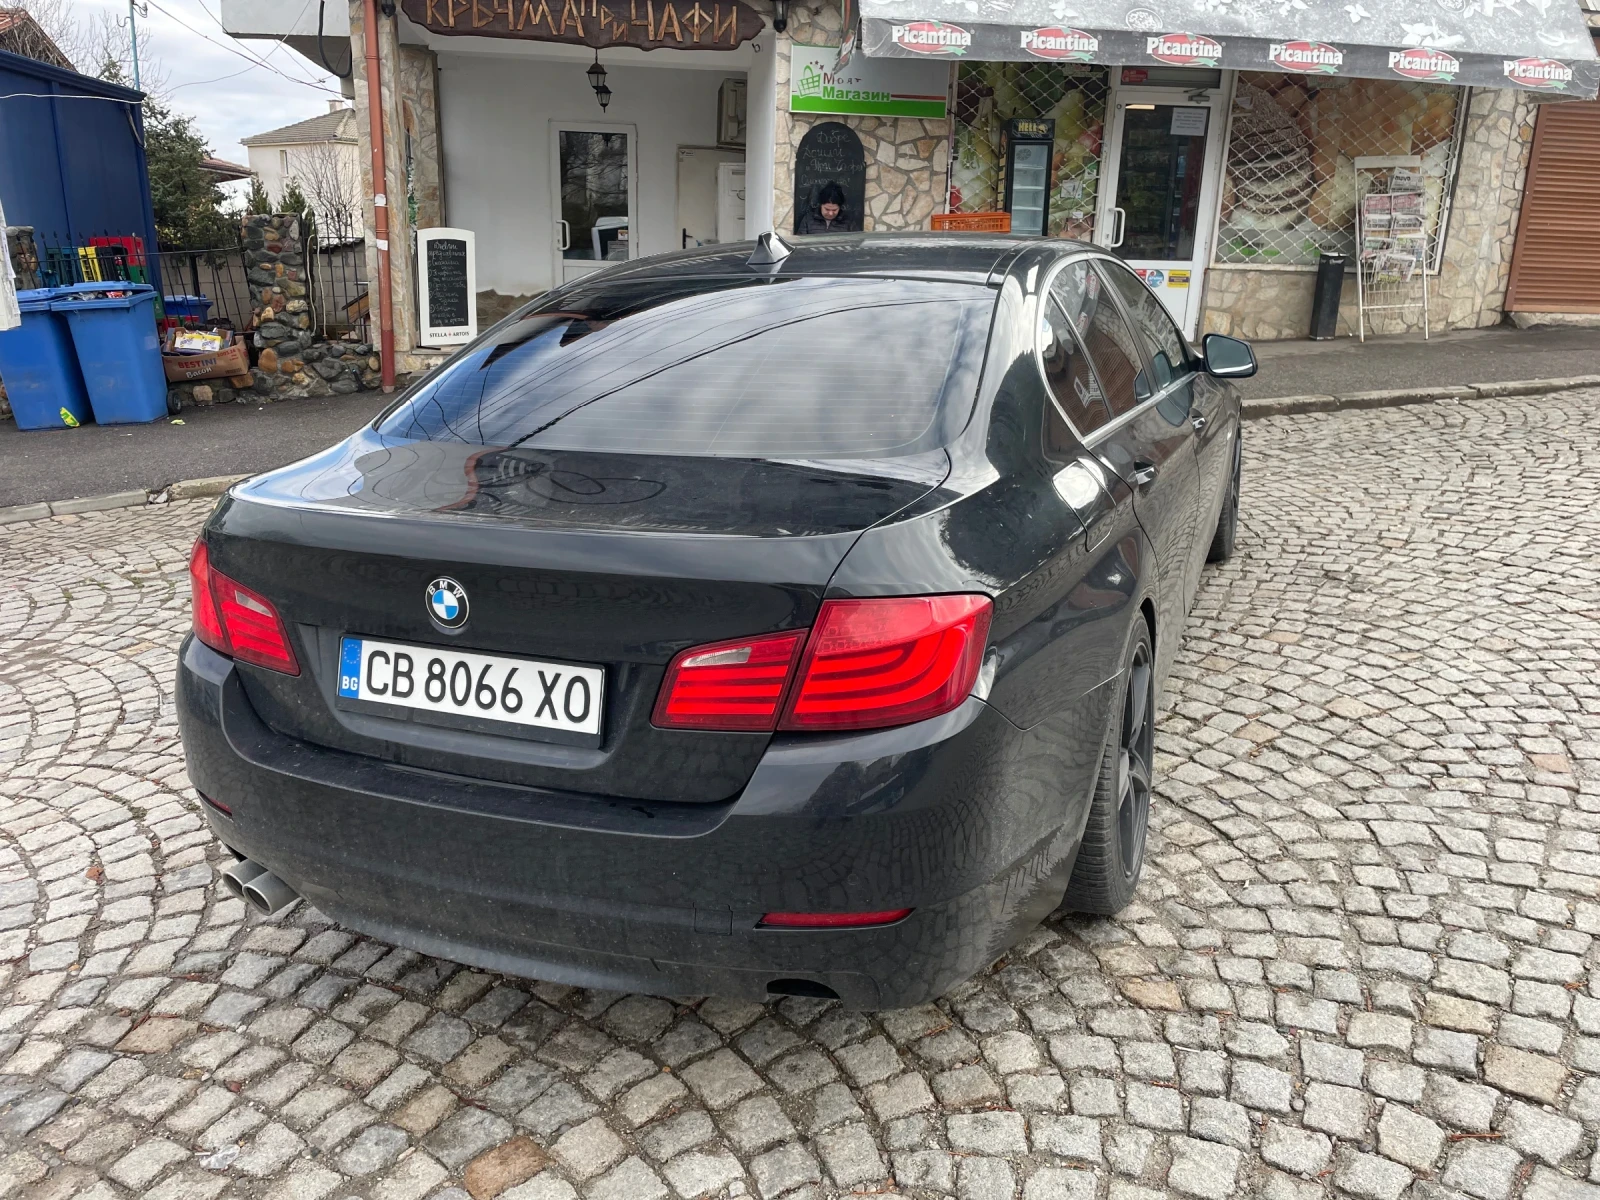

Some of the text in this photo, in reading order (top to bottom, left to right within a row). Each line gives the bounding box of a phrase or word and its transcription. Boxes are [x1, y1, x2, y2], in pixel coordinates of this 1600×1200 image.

[631, 0, 738, 45] ЧАФИ
[891, 25, 972, 46] Picantina
[1020, 31, 1099, 52] Picantina
[1147, 37, 1223, 58] Picantina
[1268, 43, 1344, 65] Picantina
[1388, 51, 1460, 74] Picantina
[1503, 60, 1573, 81] Picantina
[822, 86, 892, 102] Магазин
[816, 130, 851, 147] Добре
[178, 357, 217, 369] BESTINI
[342, 675, 358, 690] BG
[366, 650, 591, 724] CB 8066 XO
